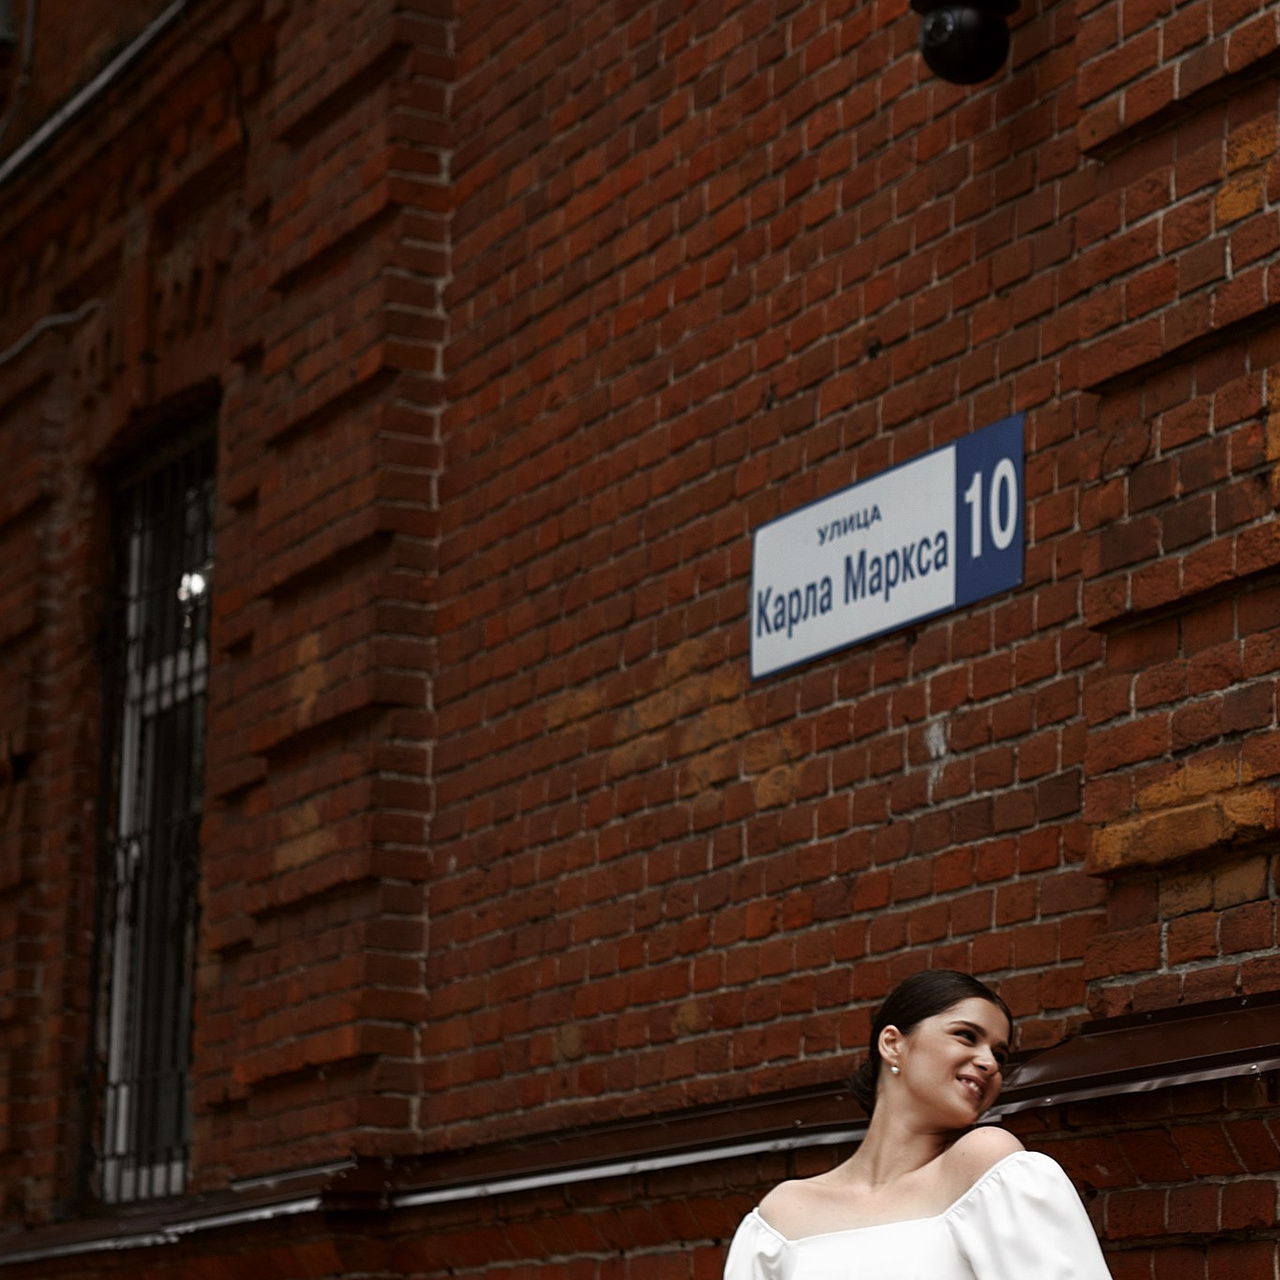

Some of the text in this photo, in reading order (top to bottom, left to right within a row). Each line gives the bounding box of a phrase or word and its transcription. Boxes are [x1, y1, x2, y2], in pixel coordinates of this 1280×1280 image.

[817, 504, 882, 546] УЛИЦА
[964, 457, 1018, 559] 10
[756, 529, 949, 639] Карла Маркса
